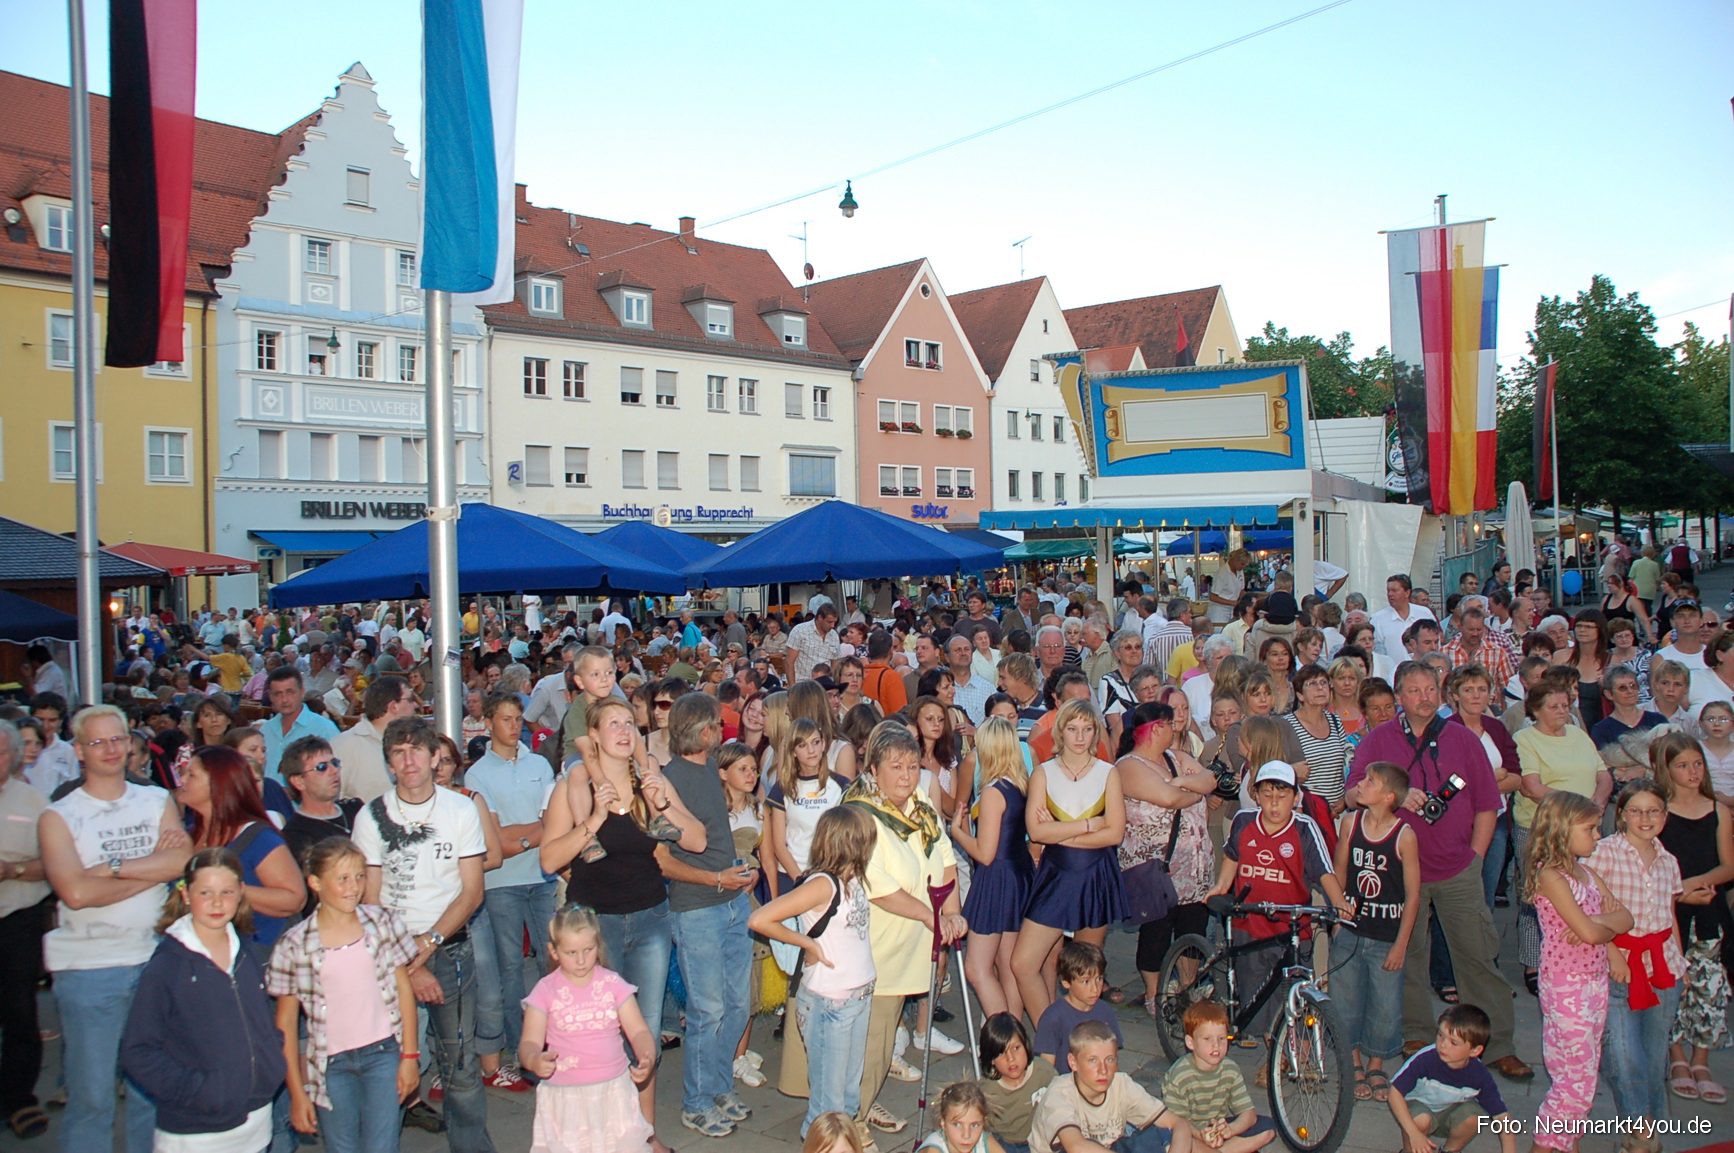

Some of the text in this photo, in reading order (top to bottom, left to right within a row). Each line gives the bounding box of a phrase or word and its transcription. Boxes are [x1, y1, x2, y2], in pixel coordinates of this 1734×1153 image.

[313, 396, 418, 416] BRILLEN WEBER
[508, 463, 520, 481] R
[301, 500, 427, 519] BRILLEN WEBER
[602, 503, 754, 520] Buchhaung Rupprecht
[797, 797, 828, 806] Corona
[118, 823, 149, 837] ARMY
[433, 842, 453, 860] 72
[1352, 847, 1388, 872] 012
[1240, 864, 1291, 884] OPEL
